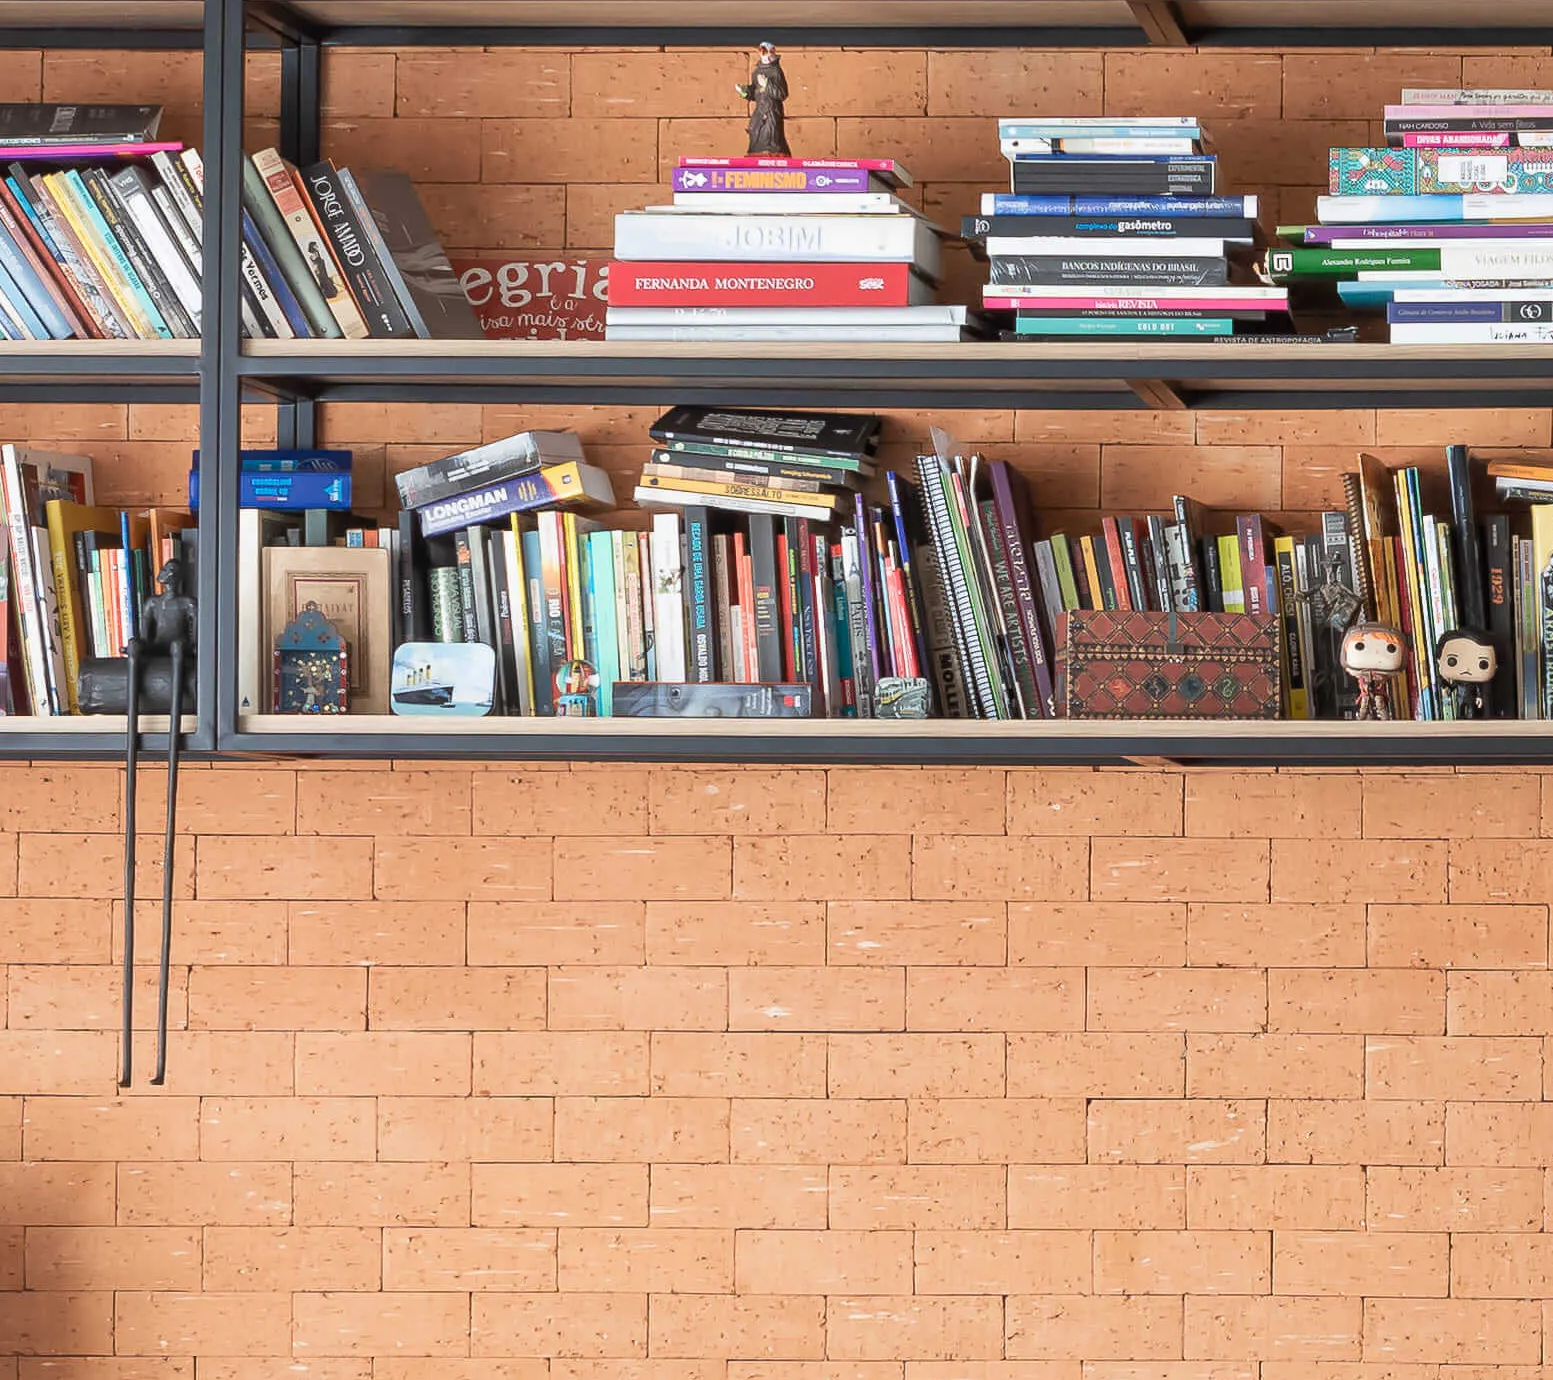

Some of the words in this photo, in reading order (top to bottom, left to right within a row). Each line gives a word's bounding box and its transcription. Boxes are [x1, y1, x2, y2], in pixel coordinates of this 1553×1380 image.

[725, 171, 808, 189] FEMINISMO
[307, 171, 345, 221] JORGE
[330, 219, 369, 269] AMADO
[1117, 220, 1172, 233] gasômetro
[1061, 261, 1099, 271] BANCOS
[1101, 260, 1151, 272] INDÍGENAS
[1152, 262, 1167, 272] DO
[1167, 263, 1199, 273] BRASIL
[1474, 252, 1523, 266] VIAGEM
[634, 277, 710, 290] FERNANDA
[714, 277, 815, 291] MONTENEGRO
[1118, 300, 1159, 309] REVISTA
[517, 310, 569, 328] mais
[424, 487, 508, 522] LONGMAN
[991, 559, 1009, 584] WE
[997, 584, 1015, 610] ARE
[1003, 609, 1029, 665] ARTISTS
